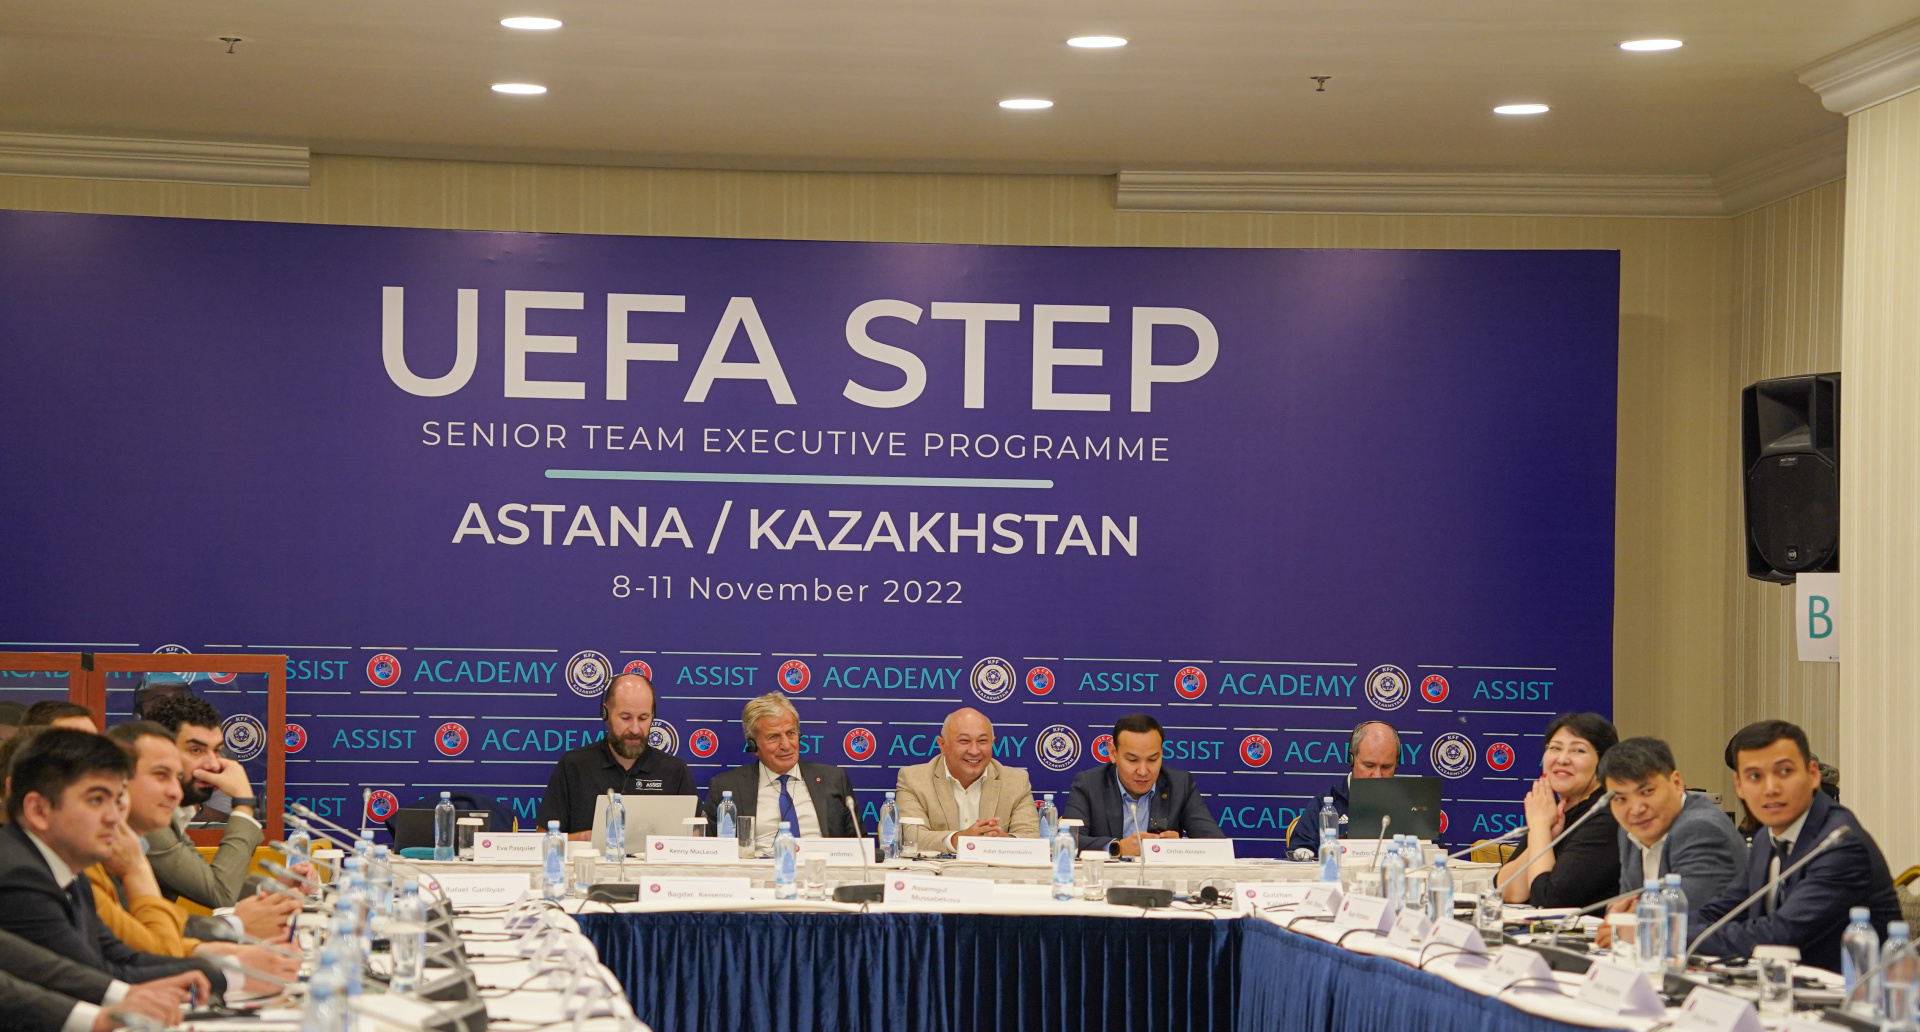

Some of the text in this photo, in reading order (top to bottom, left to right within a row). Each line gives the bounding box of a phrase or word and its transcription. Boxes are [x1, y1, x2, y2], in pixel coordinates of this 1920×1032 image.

[381, 286, 1219, 413] UEFA STEP
[422, 421, 1170, 462] SENIOR TEAM EXECUTIVE PROGRAMME
[451, 500, 1138, 557] ASTANA / KAZAKHSTAN
[612, 574, 963, 604] 8-11 November 2022
[1809, 595, 1832, 639] B
[285, 660, 349, 680] SSIST
[374, 656, 394, 664] UEFA
[784, 662, 804, 670] UEFA
[413, 660, 557, 684] ACADEMY
[676, 665, 759, 686] ASSIST
[822, 666, 963, 690] ACADEMY
[1031, 668, 1049, 676] UEFA
[1078, 672, 1159, 692] ASSIST
[1219, 673, 1357, 697] ACADEMY
[1473, 680, 1554, 700] ASSIST
[332, 729, 417, 749] ASSIST
[442, 725, 461, 733] UEFA
[850, 730, 870, 738] UEFA
[481, 728, 605, 752] ACADEM
[888, 734, 1028, 758] ACAMY
[1162, 740, 1224, 760] SSIST
[1218, 806, 1306, 829] ACAD
[1472, 813, 1525, 833] ASSI
[496, 844, 536, 853] Eva Pasquier
[669, 848, 688, 856] Kenny
[445, 885, 506, 895] Rafael Garibyan
[667, 891, 733, 899] Bagdat Kassenov
[911, 884, 948, 895] Assemgul
[1263, 891, 1293, 899] Gulzhan
